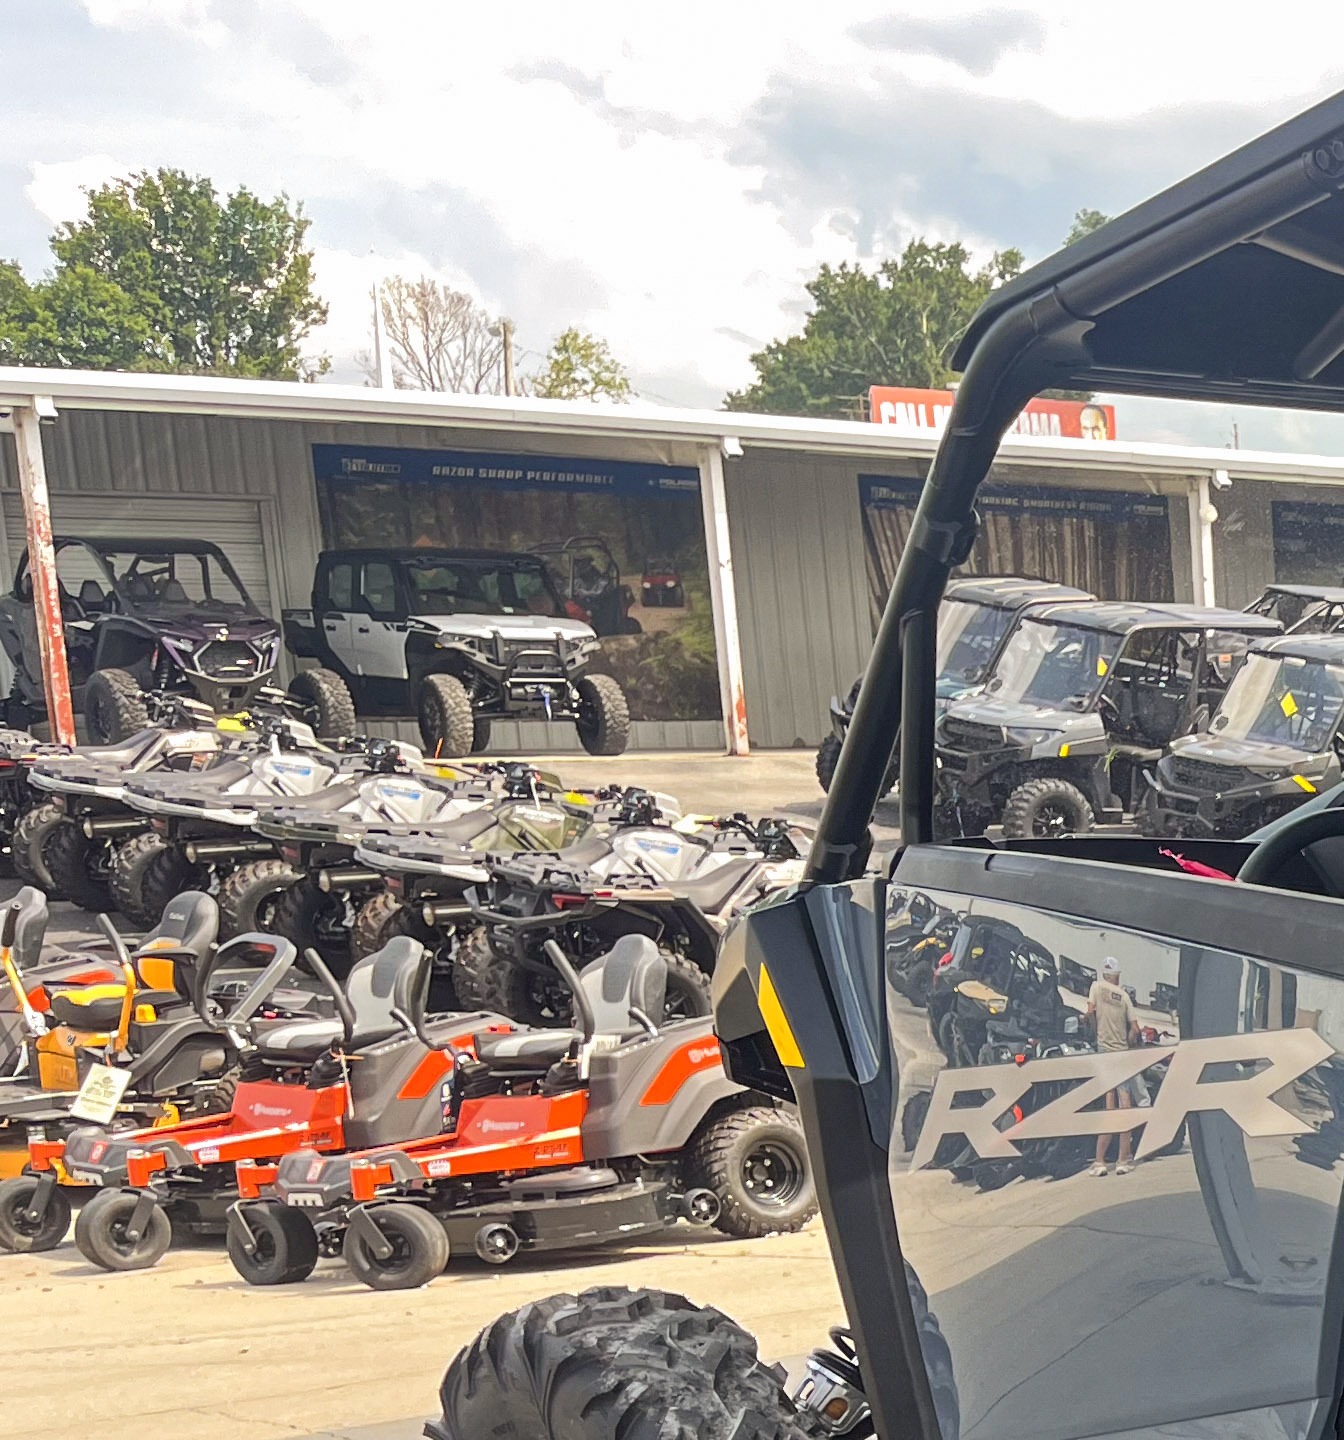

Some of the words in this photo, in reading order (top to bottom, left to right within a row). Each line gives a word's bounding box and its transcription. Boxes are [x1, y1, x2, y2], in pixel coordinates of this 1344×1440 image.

[432, 465, 475, 478] RAZOR
[478, 467, 523, 481] SHARP
[907, 1027, 1336, 1176] RZR
